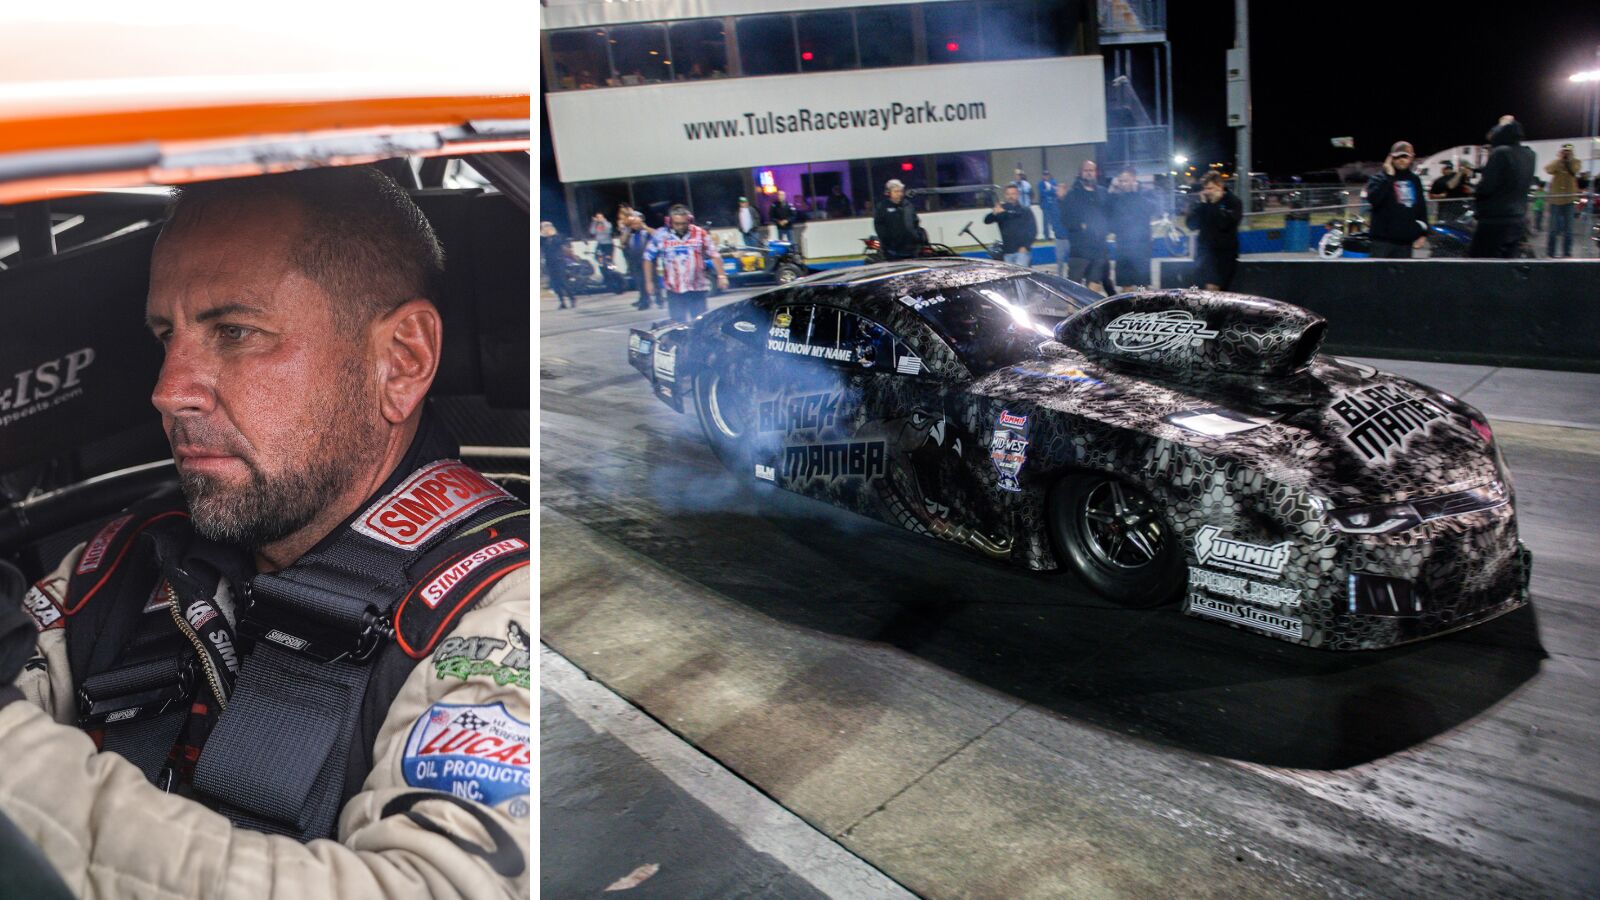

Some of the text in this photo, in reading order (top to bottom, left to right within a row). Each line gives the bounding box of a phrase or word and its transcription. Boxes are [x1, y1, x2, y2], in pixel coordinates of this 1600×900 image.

[684, 101, 987, 140] www.TulsaRacewayPark.com
[1107, 317, 1218, 337] SWITZER
[768, 340, 852, 362] YOU KNOW MY NAME
[758, 390, 843, 439] BLACK
[990, 436, 1029, 454] MID-WEST
[782, 440, 886, 482] MAMBA
[428, 541, 514, 600] SIMPSON
[267, 631, 305, 649] SIMPSON
[417, 759, 530, 788] OIL PRODUCTS
[453, 780, 483, 801] INC.
